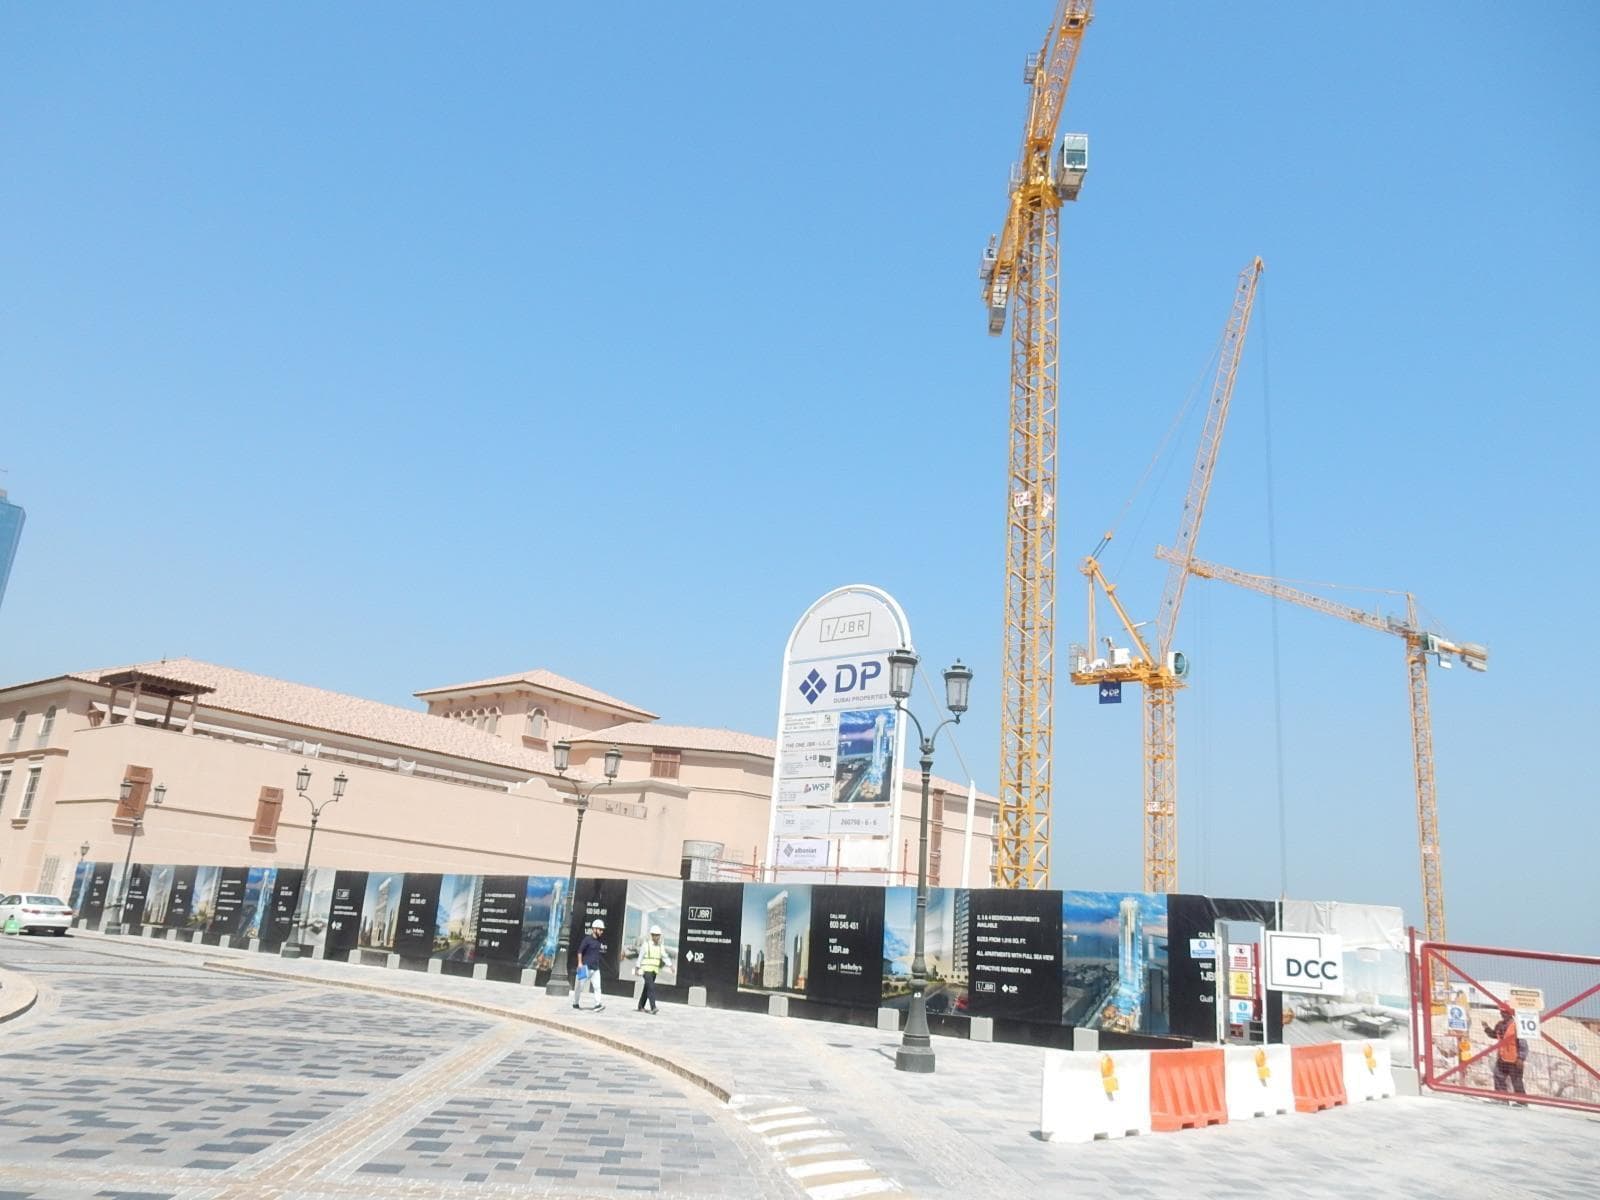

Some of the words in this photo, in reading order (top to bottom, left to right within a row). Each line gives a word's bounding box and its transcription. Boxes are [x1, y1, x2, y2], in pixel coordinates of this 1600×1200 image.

[835, 661, 882, 693] DP
[852, 693, 888, 702] PROPERTIES
[812, 783, 831, 792] WSP
[695, 952, 705, 962] DP
[1286, 958, 1338, 980] DCC
[1520, 1020, 1537, 1032] 10
